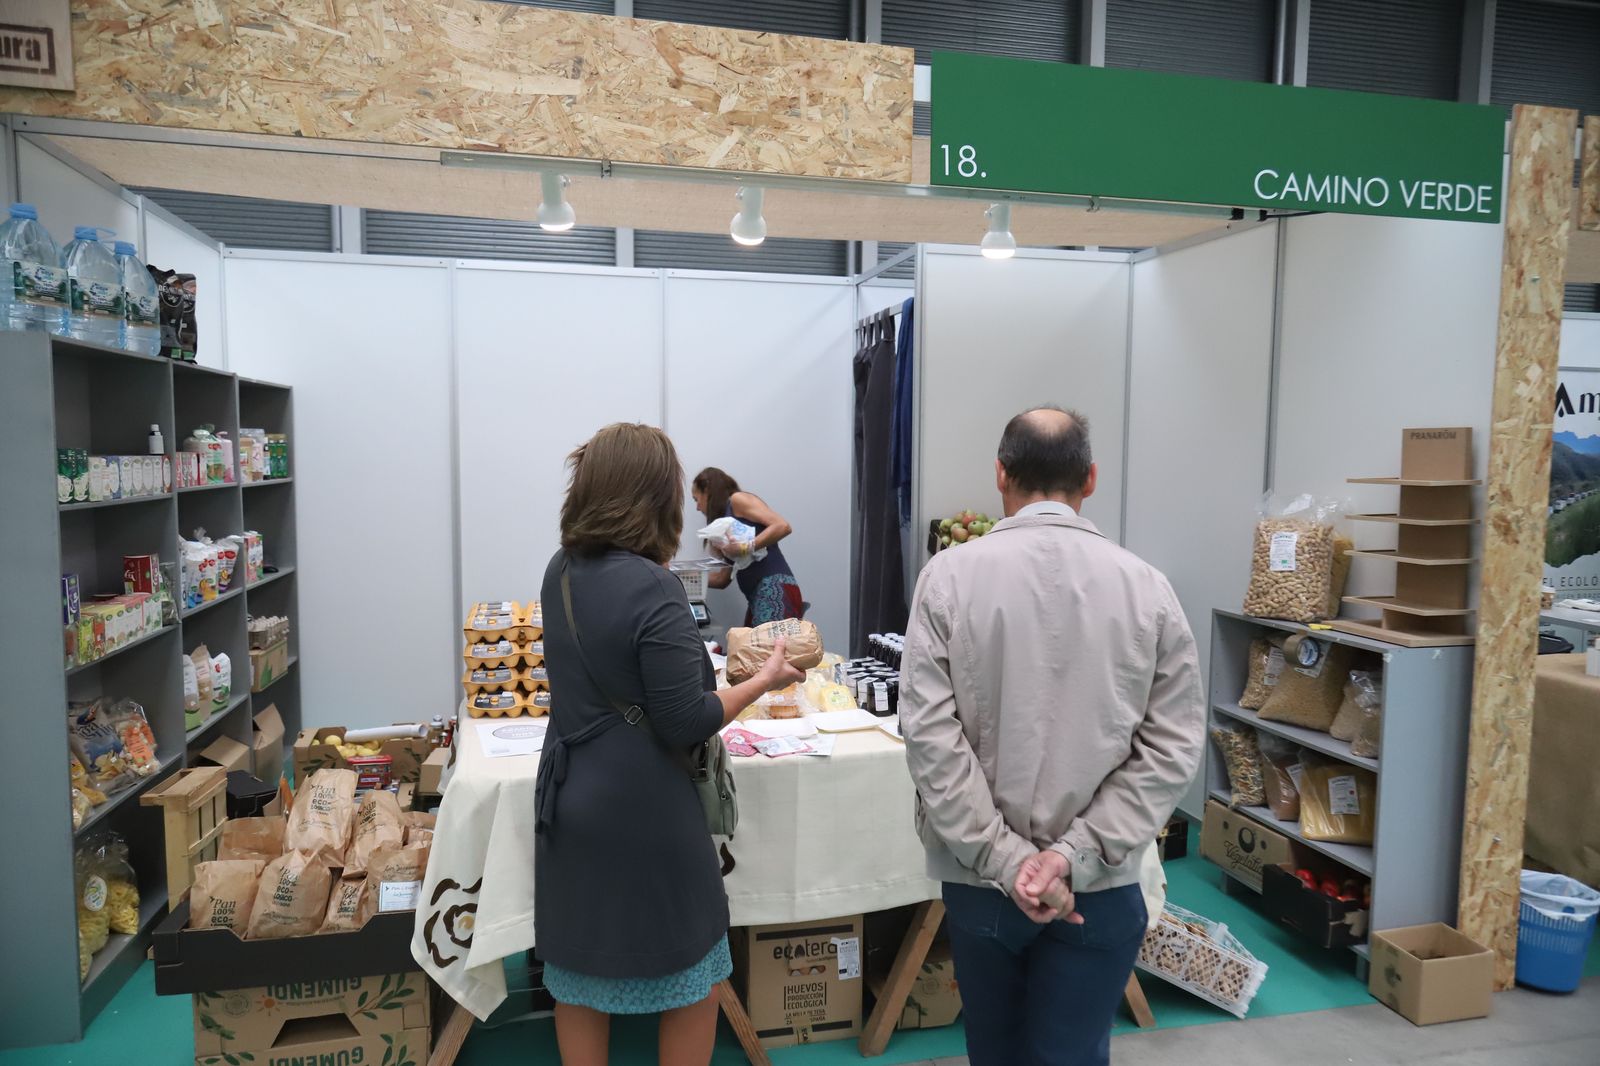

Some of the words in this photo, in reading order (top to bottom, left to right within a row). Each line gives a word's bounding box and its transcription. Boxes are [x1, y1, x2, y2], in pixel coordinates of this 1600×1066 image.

[941, 144, 987, 178] 18.
[1254, 169, 1390, 207] CAMINO
[1399, 180, 1493, 214] VERDE
[213, 898, 236, 908] Pan
[213, 908, 235, 916] 100%
[787, 982, 824, 995] HUEVOS
[787, 999, 823, 1010] ECOLÓGICA
